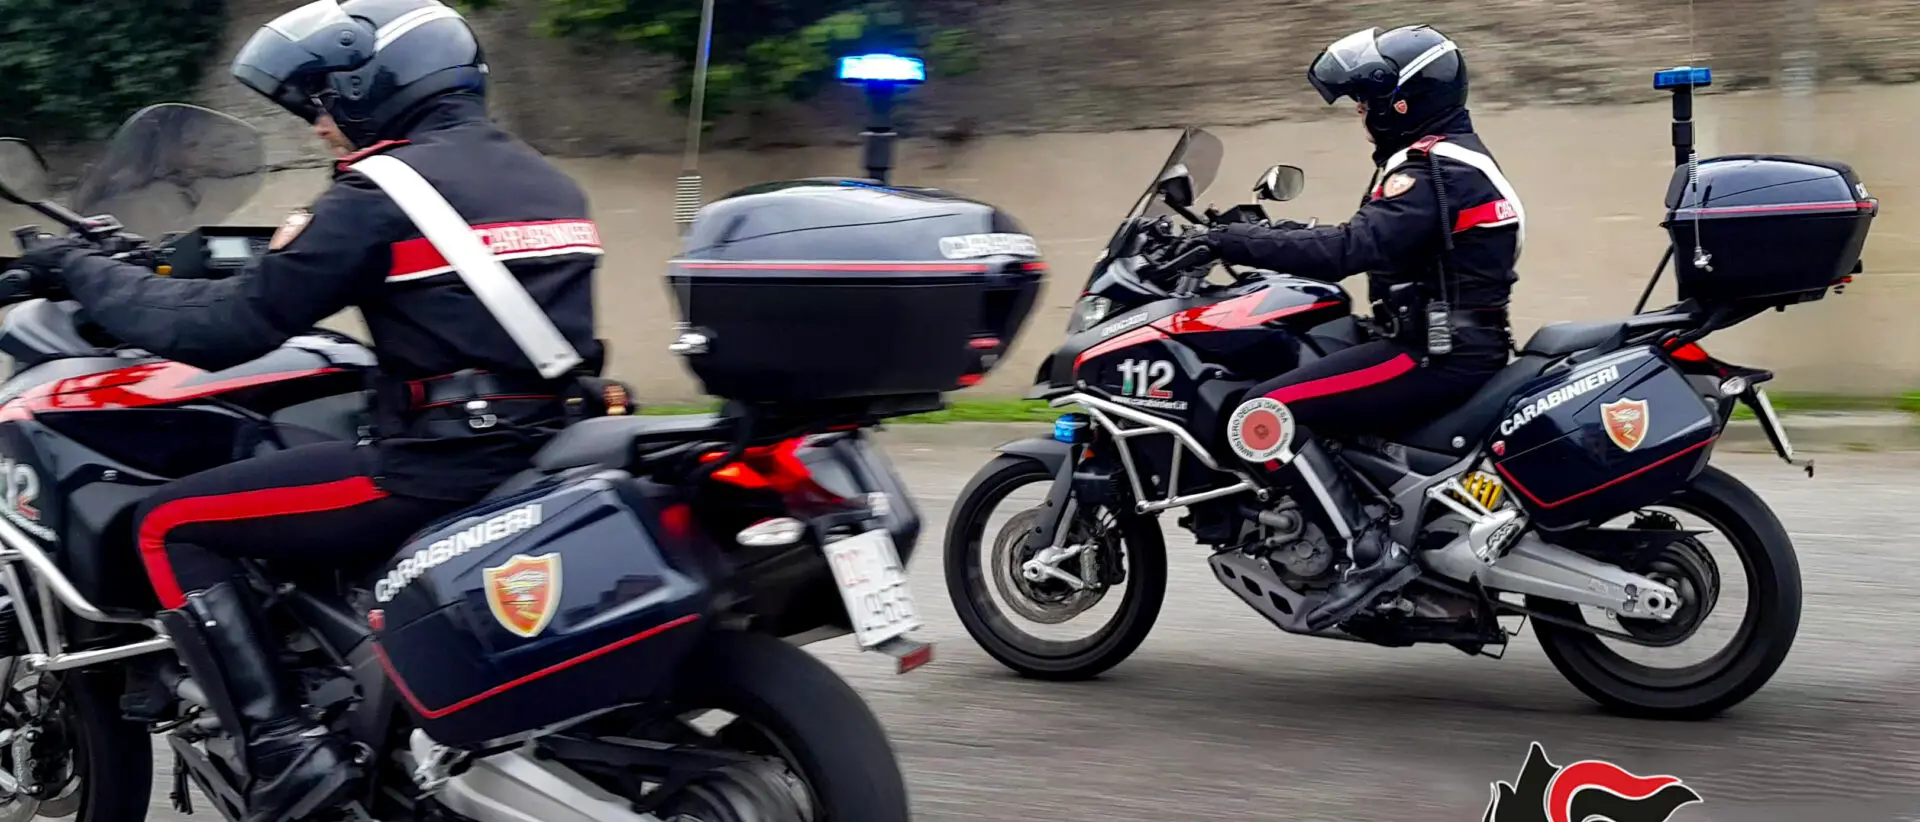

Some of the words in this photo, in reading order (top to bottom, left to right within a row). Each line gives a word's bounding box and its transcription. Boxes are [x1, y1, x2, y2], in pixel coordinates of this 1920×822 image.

[1117, 358, 1175, 399] 112
[1501, 365, 1620, 437] CARABINIERI
[0, 458, 41, 520] 12
[374, 503, 543, 603] CARABINIERI
